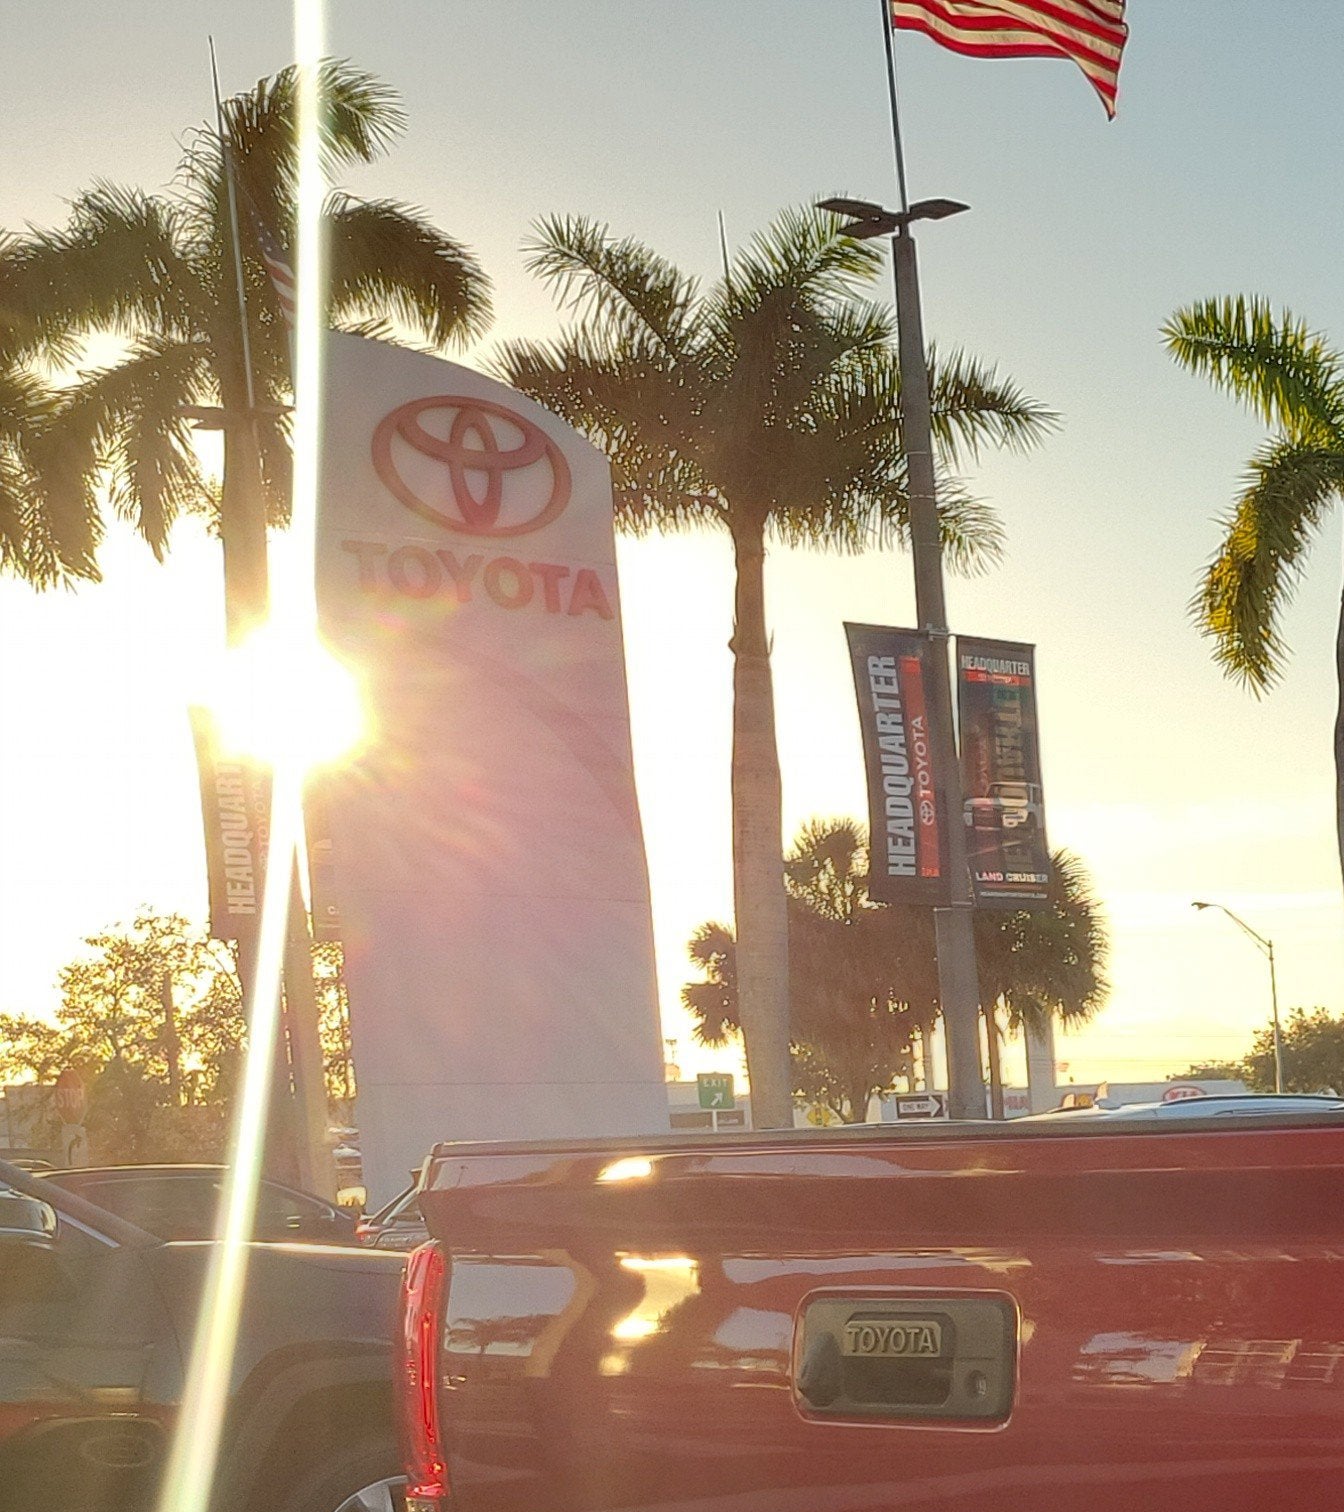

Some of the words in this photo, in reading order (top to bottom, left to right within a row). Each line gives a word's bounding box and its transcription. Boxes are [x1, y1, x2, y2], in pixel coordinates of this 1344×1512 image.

[341, 540, 615, 621] TOYOTA
[868, 655, 916, 877] HEADQUARTER
[910, 715, 931, 797] TOYOTA
[216, 761, 256, 915] HEADQUART
[703, 1078, 728, 1088] EXIT
[845, 1326, 939, 1354] TOYOTA
